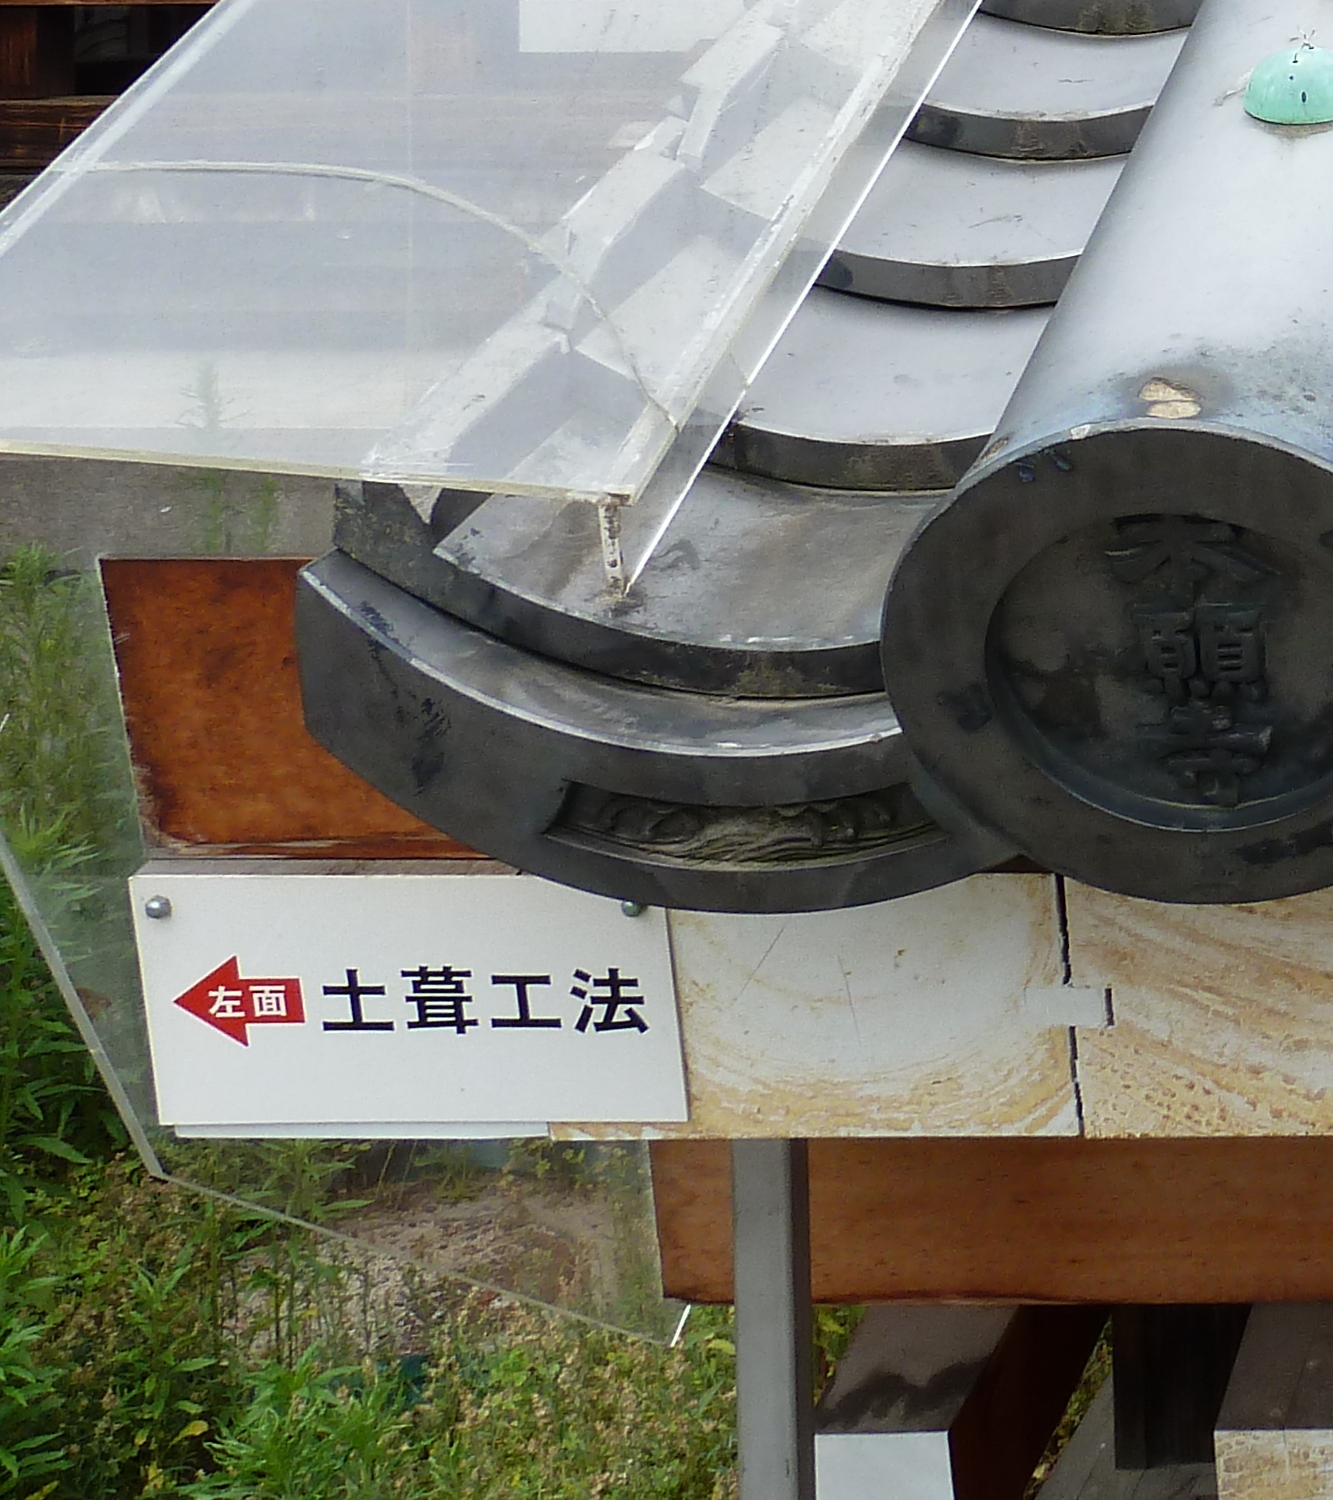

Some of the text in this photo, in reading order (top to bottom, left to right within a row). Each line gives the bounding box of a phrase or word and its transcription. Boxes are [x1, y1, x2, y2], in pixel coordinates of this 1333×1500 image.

[208, 984, 287, 1018] 左面
[322, 965, 649, 1035] 土葺工法
